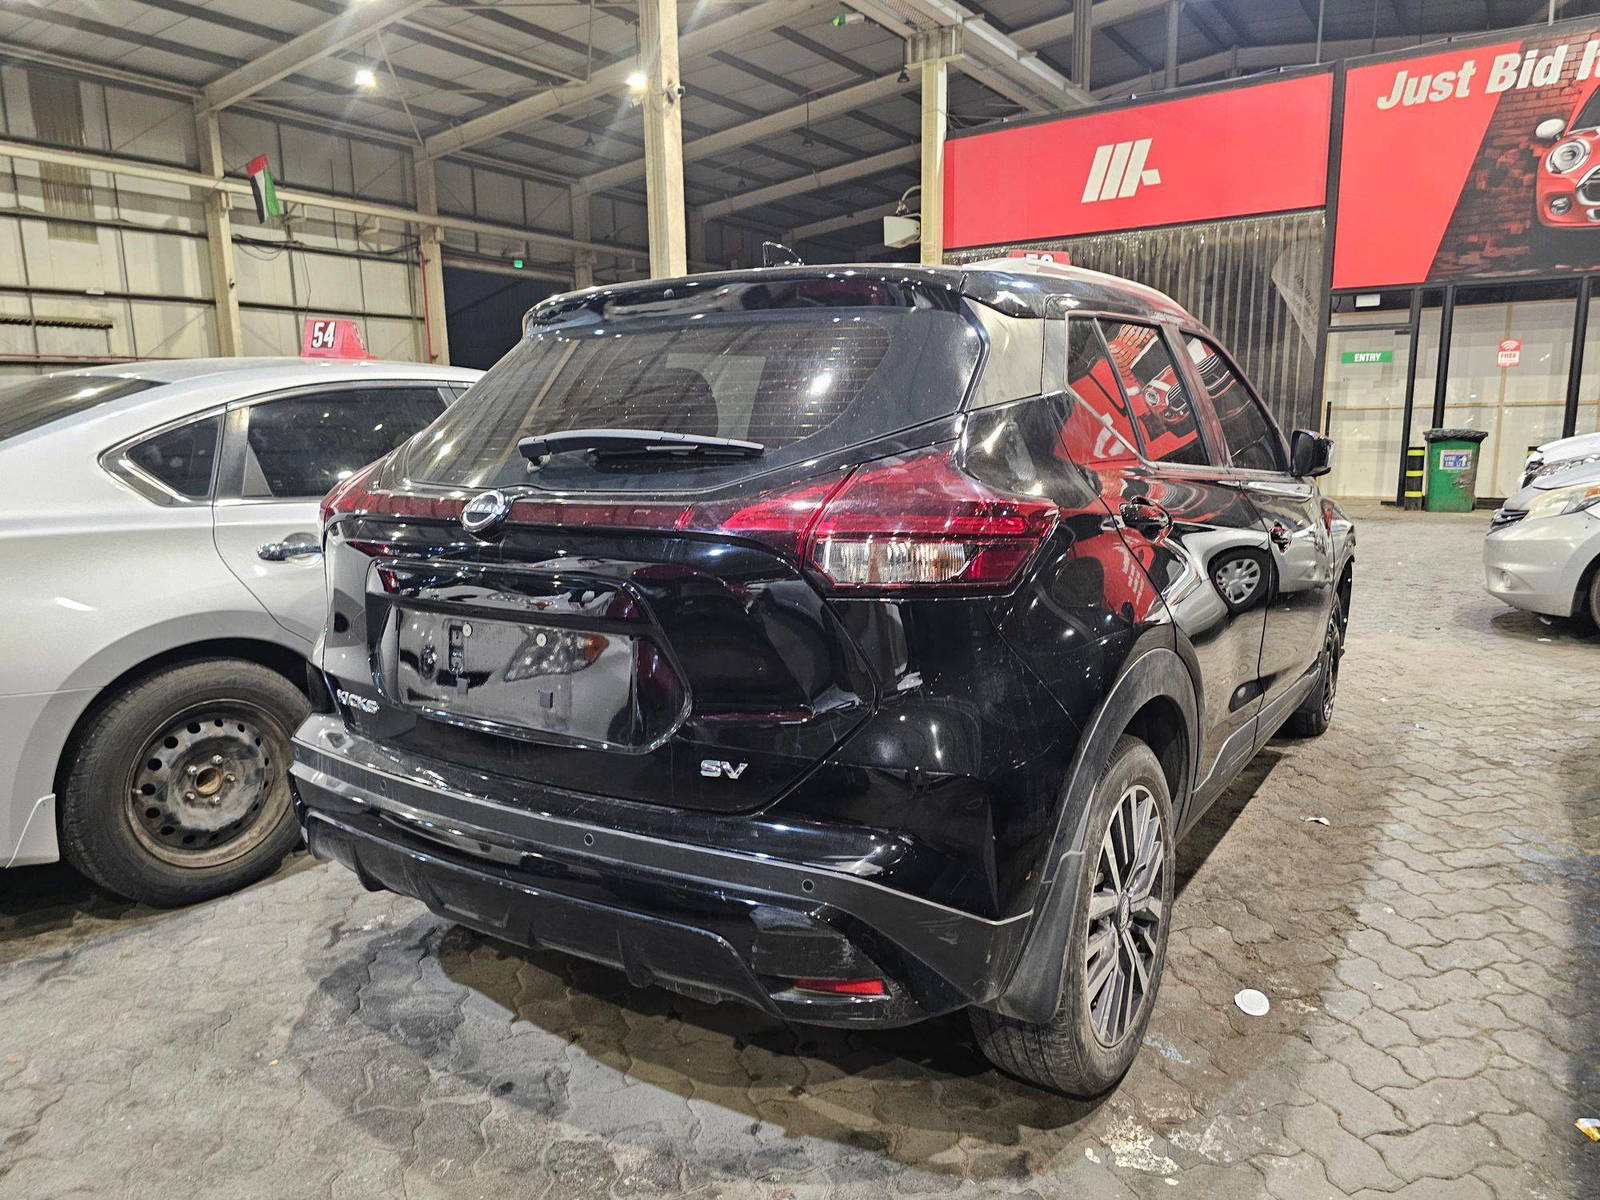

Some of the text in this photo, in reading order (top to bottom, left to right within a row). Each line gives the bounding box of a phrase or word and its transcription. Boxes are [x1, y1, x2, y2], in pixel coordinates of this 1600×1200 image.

[1376, 60, 1476, 110] Just
[1485, 44, 1568, 94] Bid
[311, 321, 336, 348] 54
[1354, 352, 1382, 362] ENTRY
[337, 689, 379, 713] KICKS
[701, 760, 748, 779] SV
